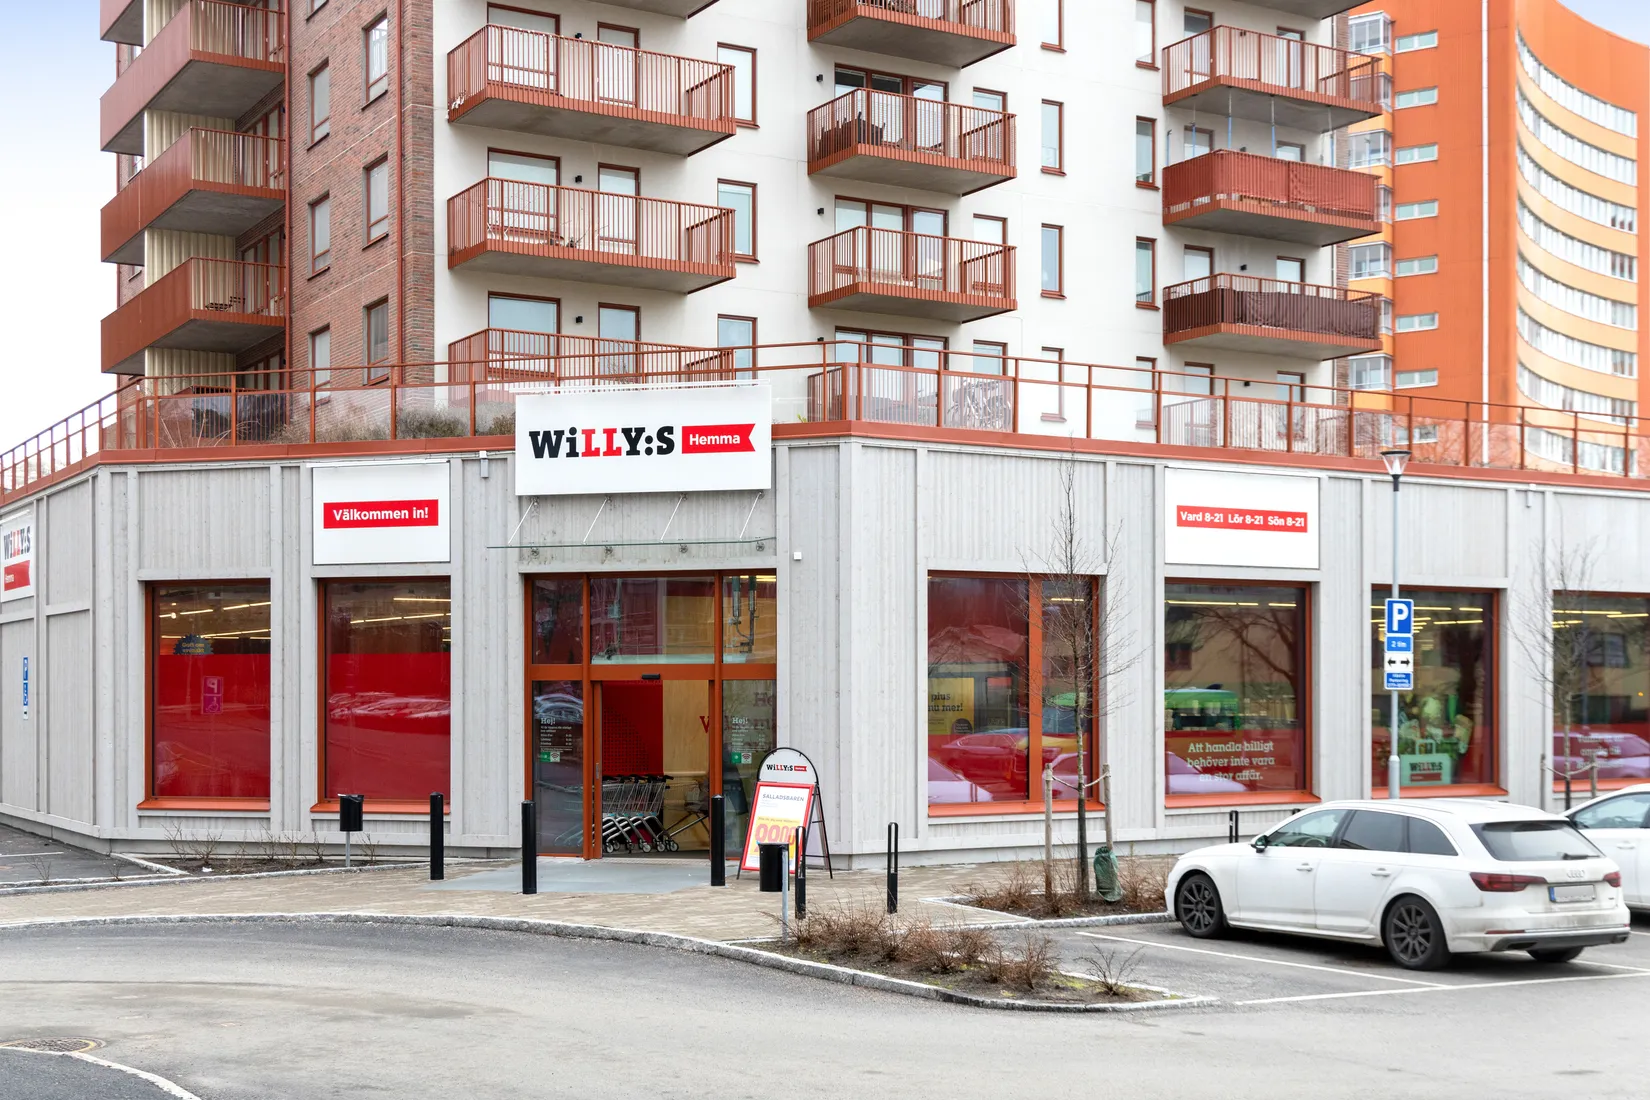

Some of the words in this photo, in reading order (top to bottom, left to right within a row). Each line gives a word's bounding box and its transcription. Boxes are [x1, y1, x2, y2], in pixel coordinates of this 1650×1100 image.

[528, 426, 675, 459] WiLLY:S
[689, 433, 741, 446] Hemma
[333, 508, 409, 521] Välkommen
[412, 507, 429, 519] in!
[1180, 511, 1203, 522] Vard
[1204, 512, 1224, 523] 8-21
[1228, 513, 1244, 524] Lör
[1245, 514, 1264, 525] 8-21
[1268, 515, 1285, 526] Sön
[1286, 517, 1305, 527] 8-21
[1392, 602, 1409, 631] P
[931, 691, 951, 702] plus
[941, 702, 964, 712] mer!
[541, 717, 556, 726] Hej!
[732, 716, 749, 725] Hej!
[1188, 742, 1204, 753] Att
[1205, 741, 1242, 753] handla
[1243, 740, 1274, 753] billigt
[1186, 756, 1229, 768] behöver
[1230, 755, 1250, 767] inte
[1252, 756, 1275, 766] vara
[1214, 771, 1234, 781] stor
[1235, 769, 1264, 780] affär.
[762, 793, 805, 802] SALLADSBAREN
